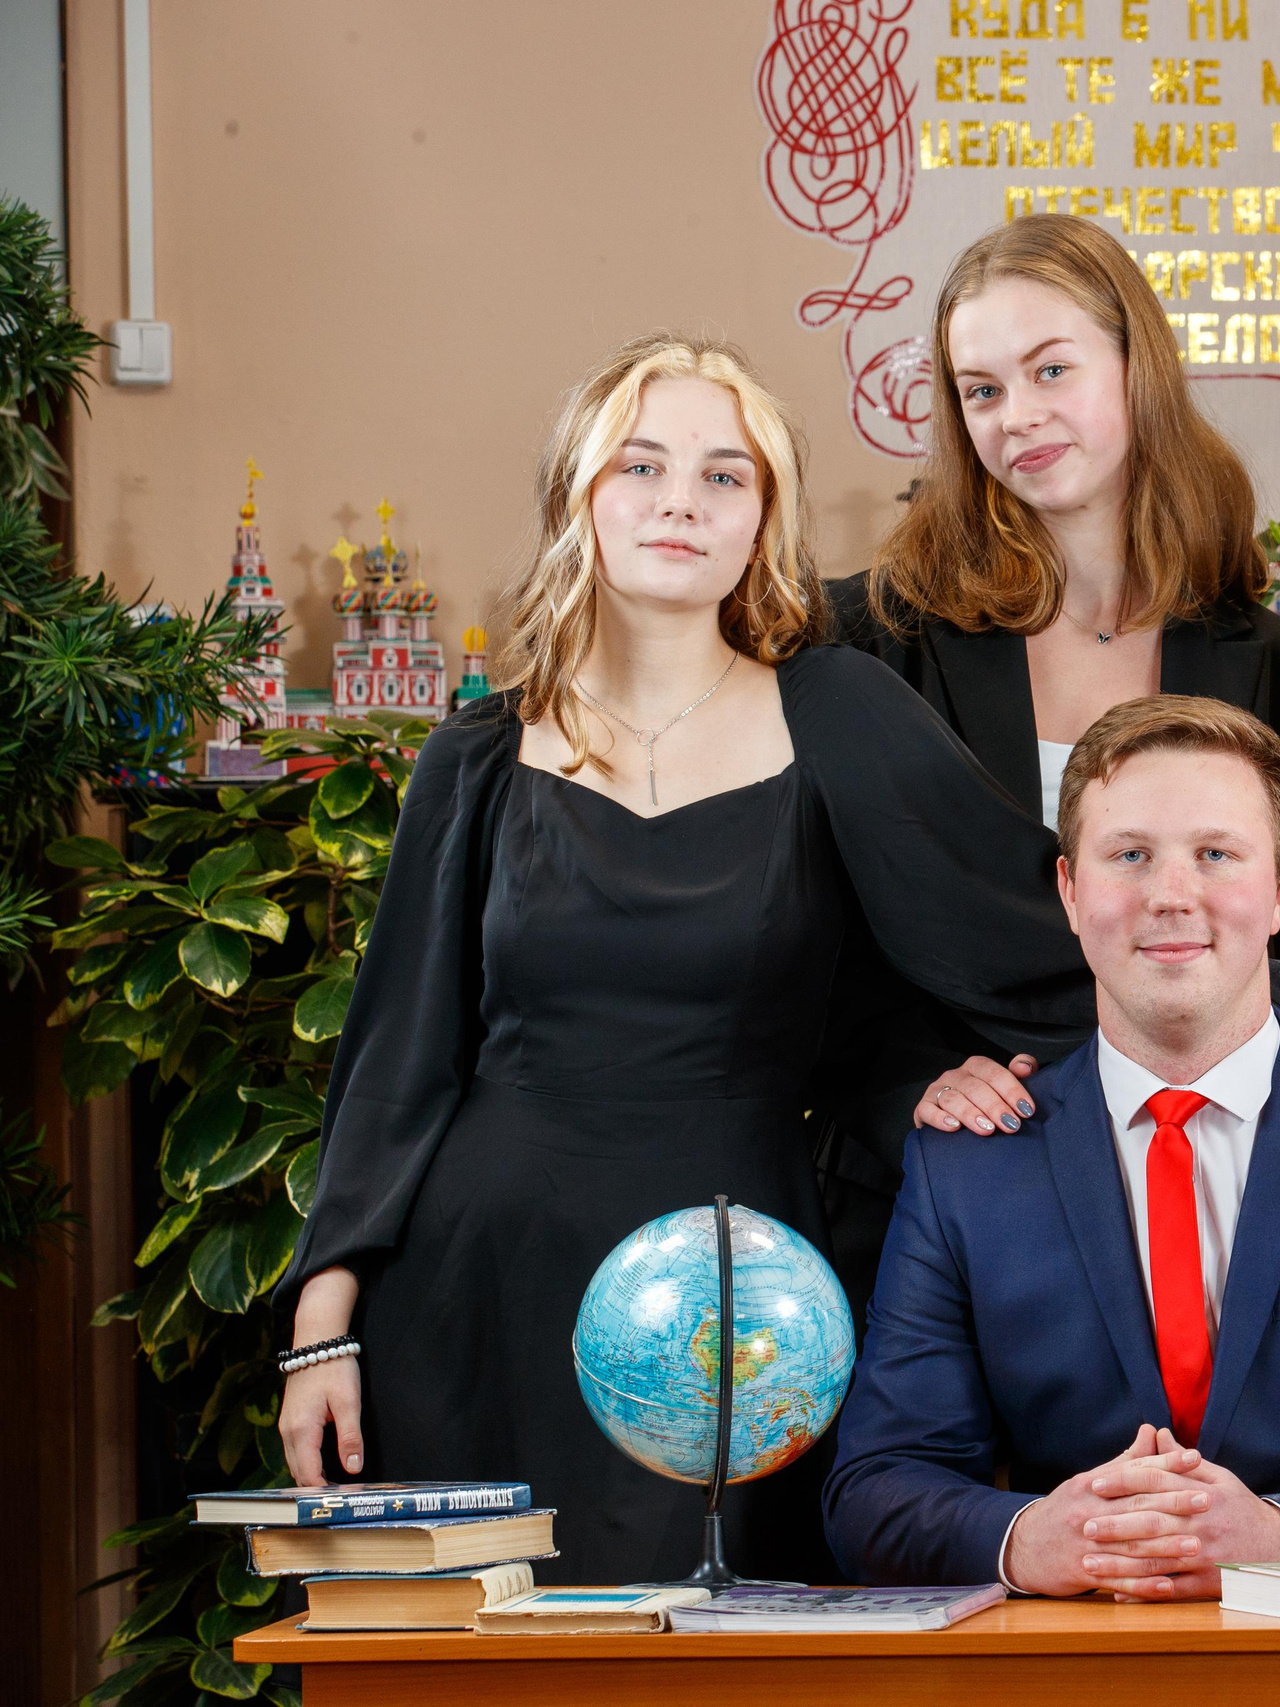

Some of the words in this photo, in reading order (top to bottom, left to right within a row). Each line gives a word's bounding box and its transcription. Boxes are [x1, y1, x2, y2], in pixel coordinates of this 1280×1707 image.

[951, 0, 1084, 40] КУДА
[1188, 0, 1249, 42] НИ
[935, 50, 1028, 104] ВСЁ
[1057, 57, 1116, 104] ТЕ
[1150, 57, 1221, 106] ЖЕ
[920, 112, 1095, 170] ЦЕЛЫЙ
[1134, 121, 1237, 168] МИР
[353, 1505, 385, 1518] АНАТОЛИЙ
[414, 1491, 441, 1512] МИНА
[447, 1487, 514, 1511] БЛУЖДАЮЩАЯ
